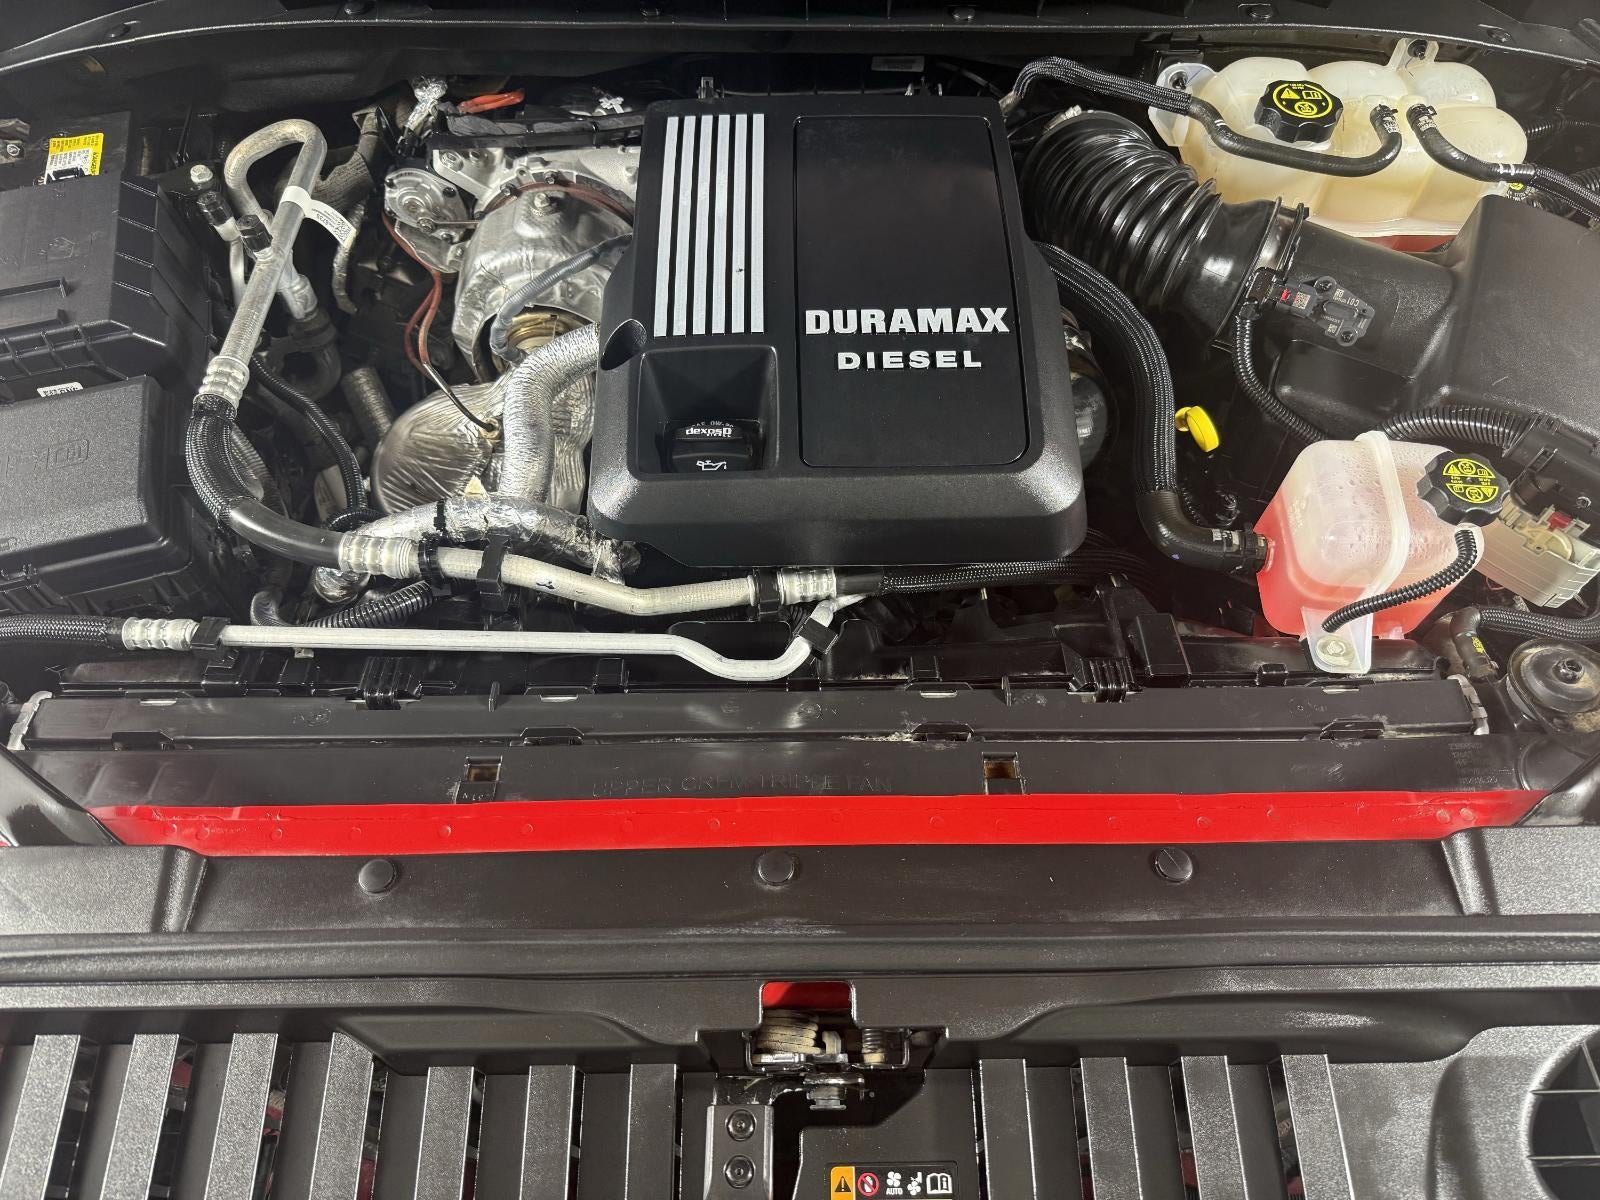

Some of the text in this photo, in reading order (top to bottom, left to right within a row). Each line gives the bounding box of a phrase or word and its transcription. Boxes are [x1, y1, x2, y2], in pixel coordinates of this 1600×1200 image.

[805, 307, 1010, 334] DURAMAX
[837, 350, 982, 370] DIESEL
[886, 1187, 903, 1196] AUTO
